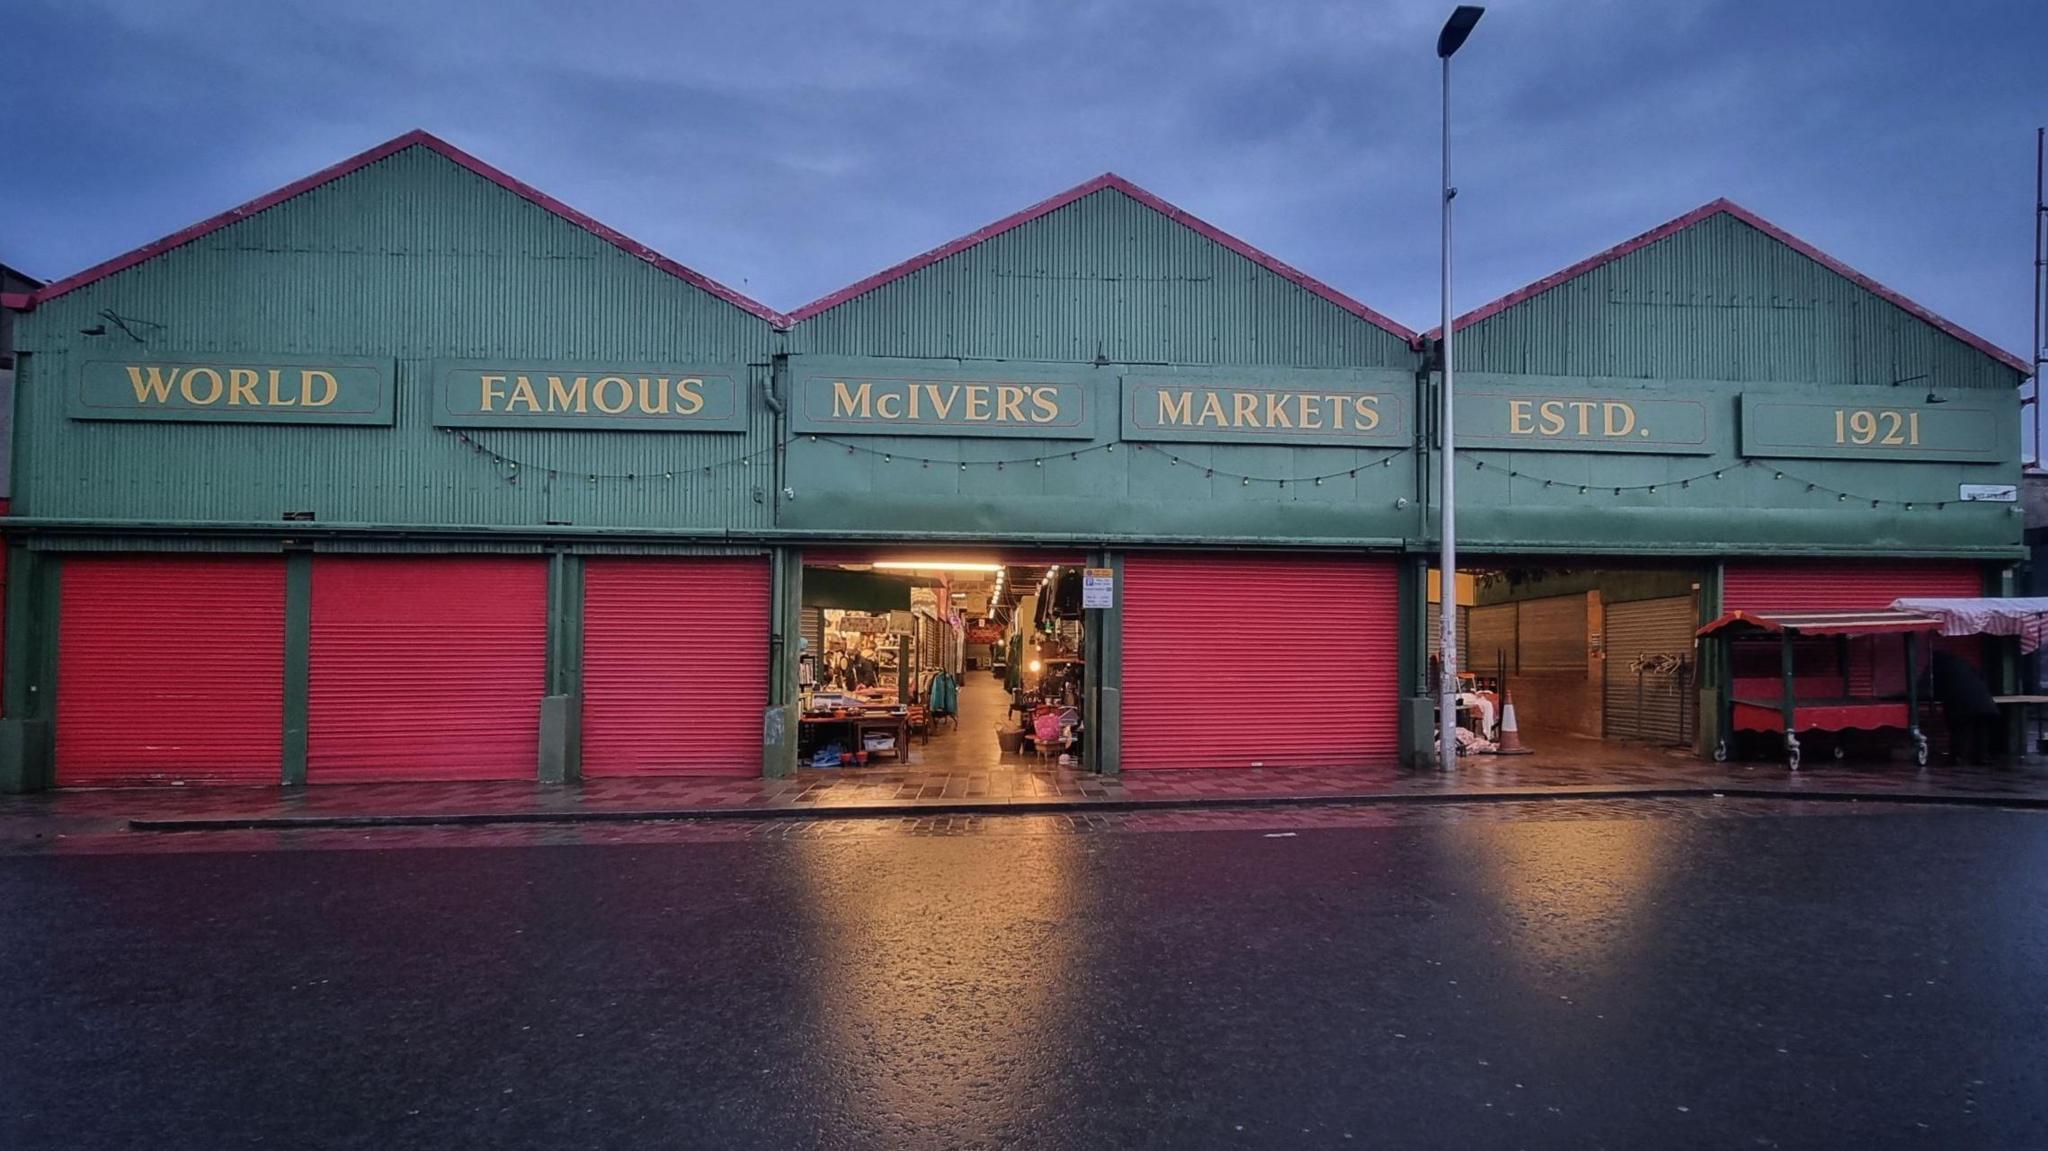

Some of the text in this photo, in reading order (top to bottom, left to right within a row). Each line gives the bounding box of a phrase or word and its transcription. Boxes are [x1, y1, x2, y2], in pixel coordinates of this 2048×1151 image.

[126, 366, 338, 408] WORLD
[480, 375, 705, 416] FAMOUS
[833, 382, 1059, 423] McIVER'S
[1157, 389, 1381, 430] MARKETS
[1509, 399, 1651, 438] ESTD.
[1834, 409, 1920, 446] 1921
